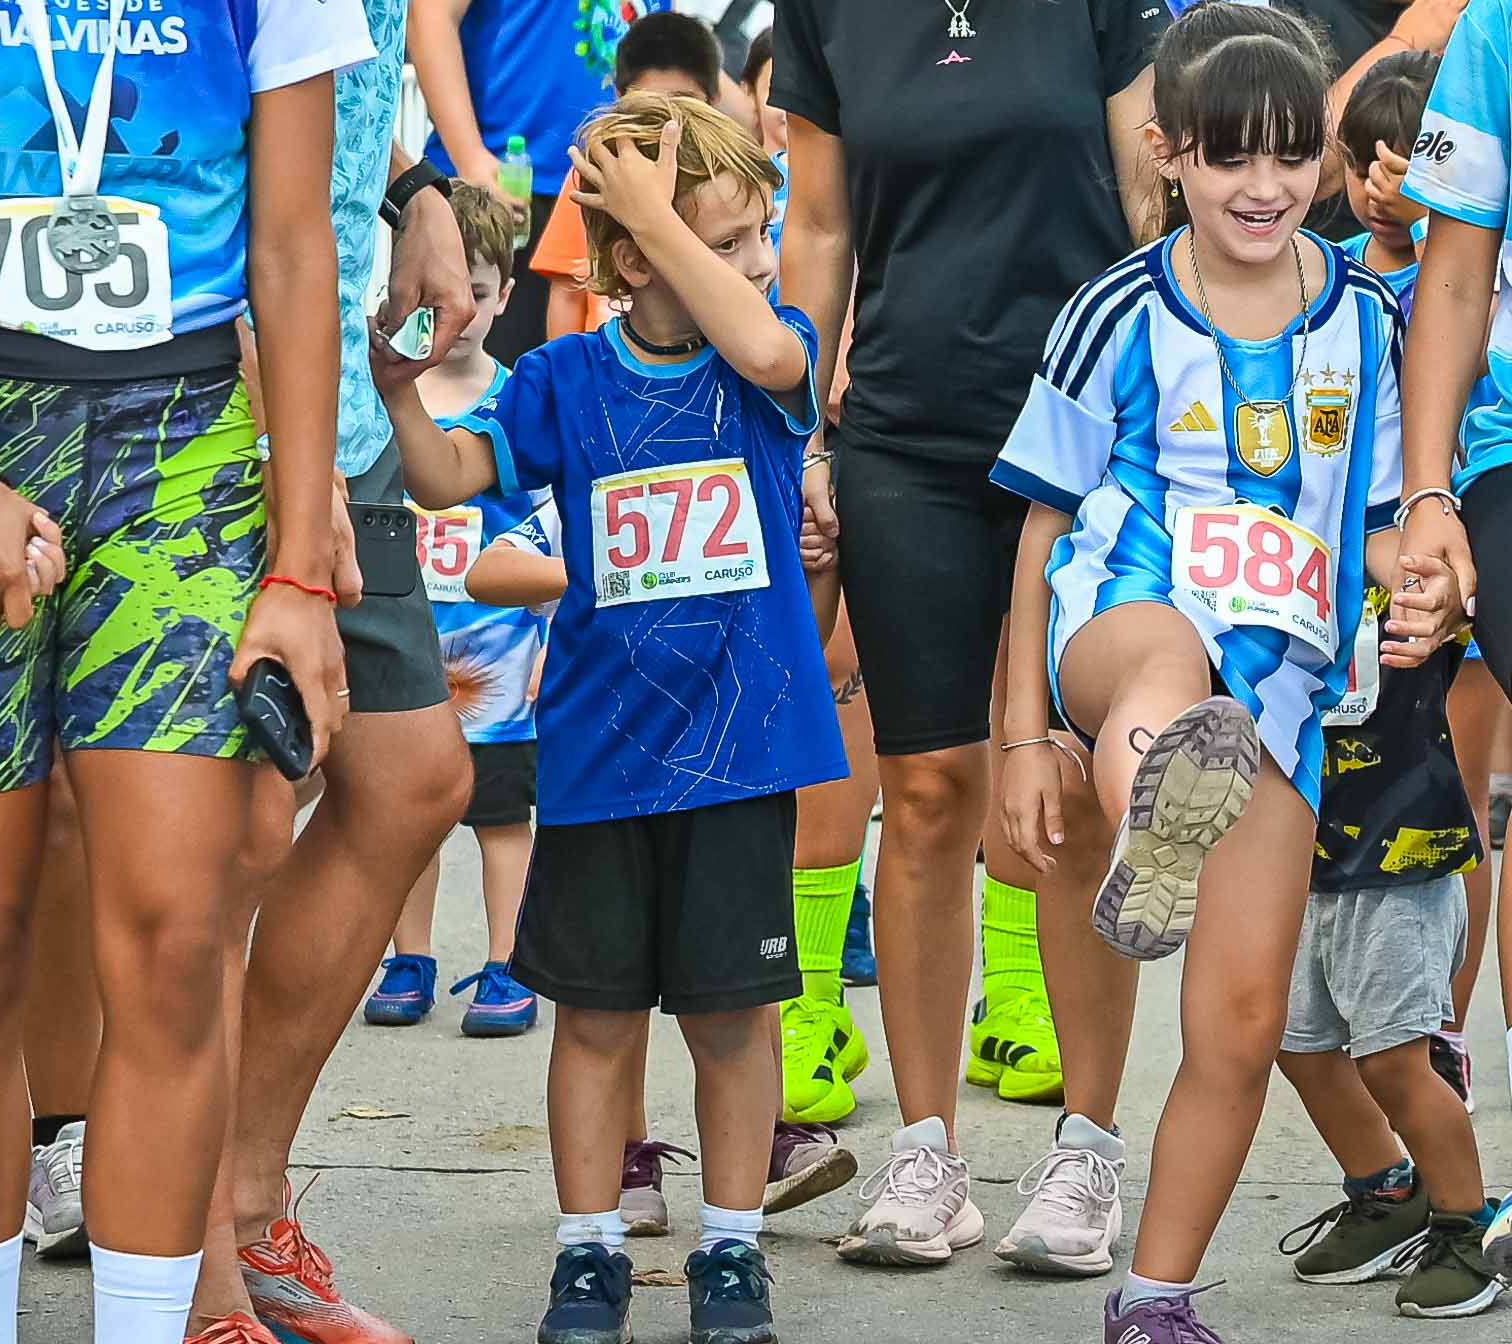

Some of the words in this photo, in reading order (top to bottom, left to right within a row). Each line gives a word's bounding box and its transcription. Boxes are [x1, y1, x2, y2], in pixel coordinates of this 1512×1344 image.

[94, 322, 154, 336] CARUSO
[604, 473, 749, 569] 572
[704, 565, 753, 581] CARUSO
[1188, 513, 1331, 623] 584
[1292, 614, 1329, 642] CARUSO
[1328, 703, 1367, 715] ARUSO
